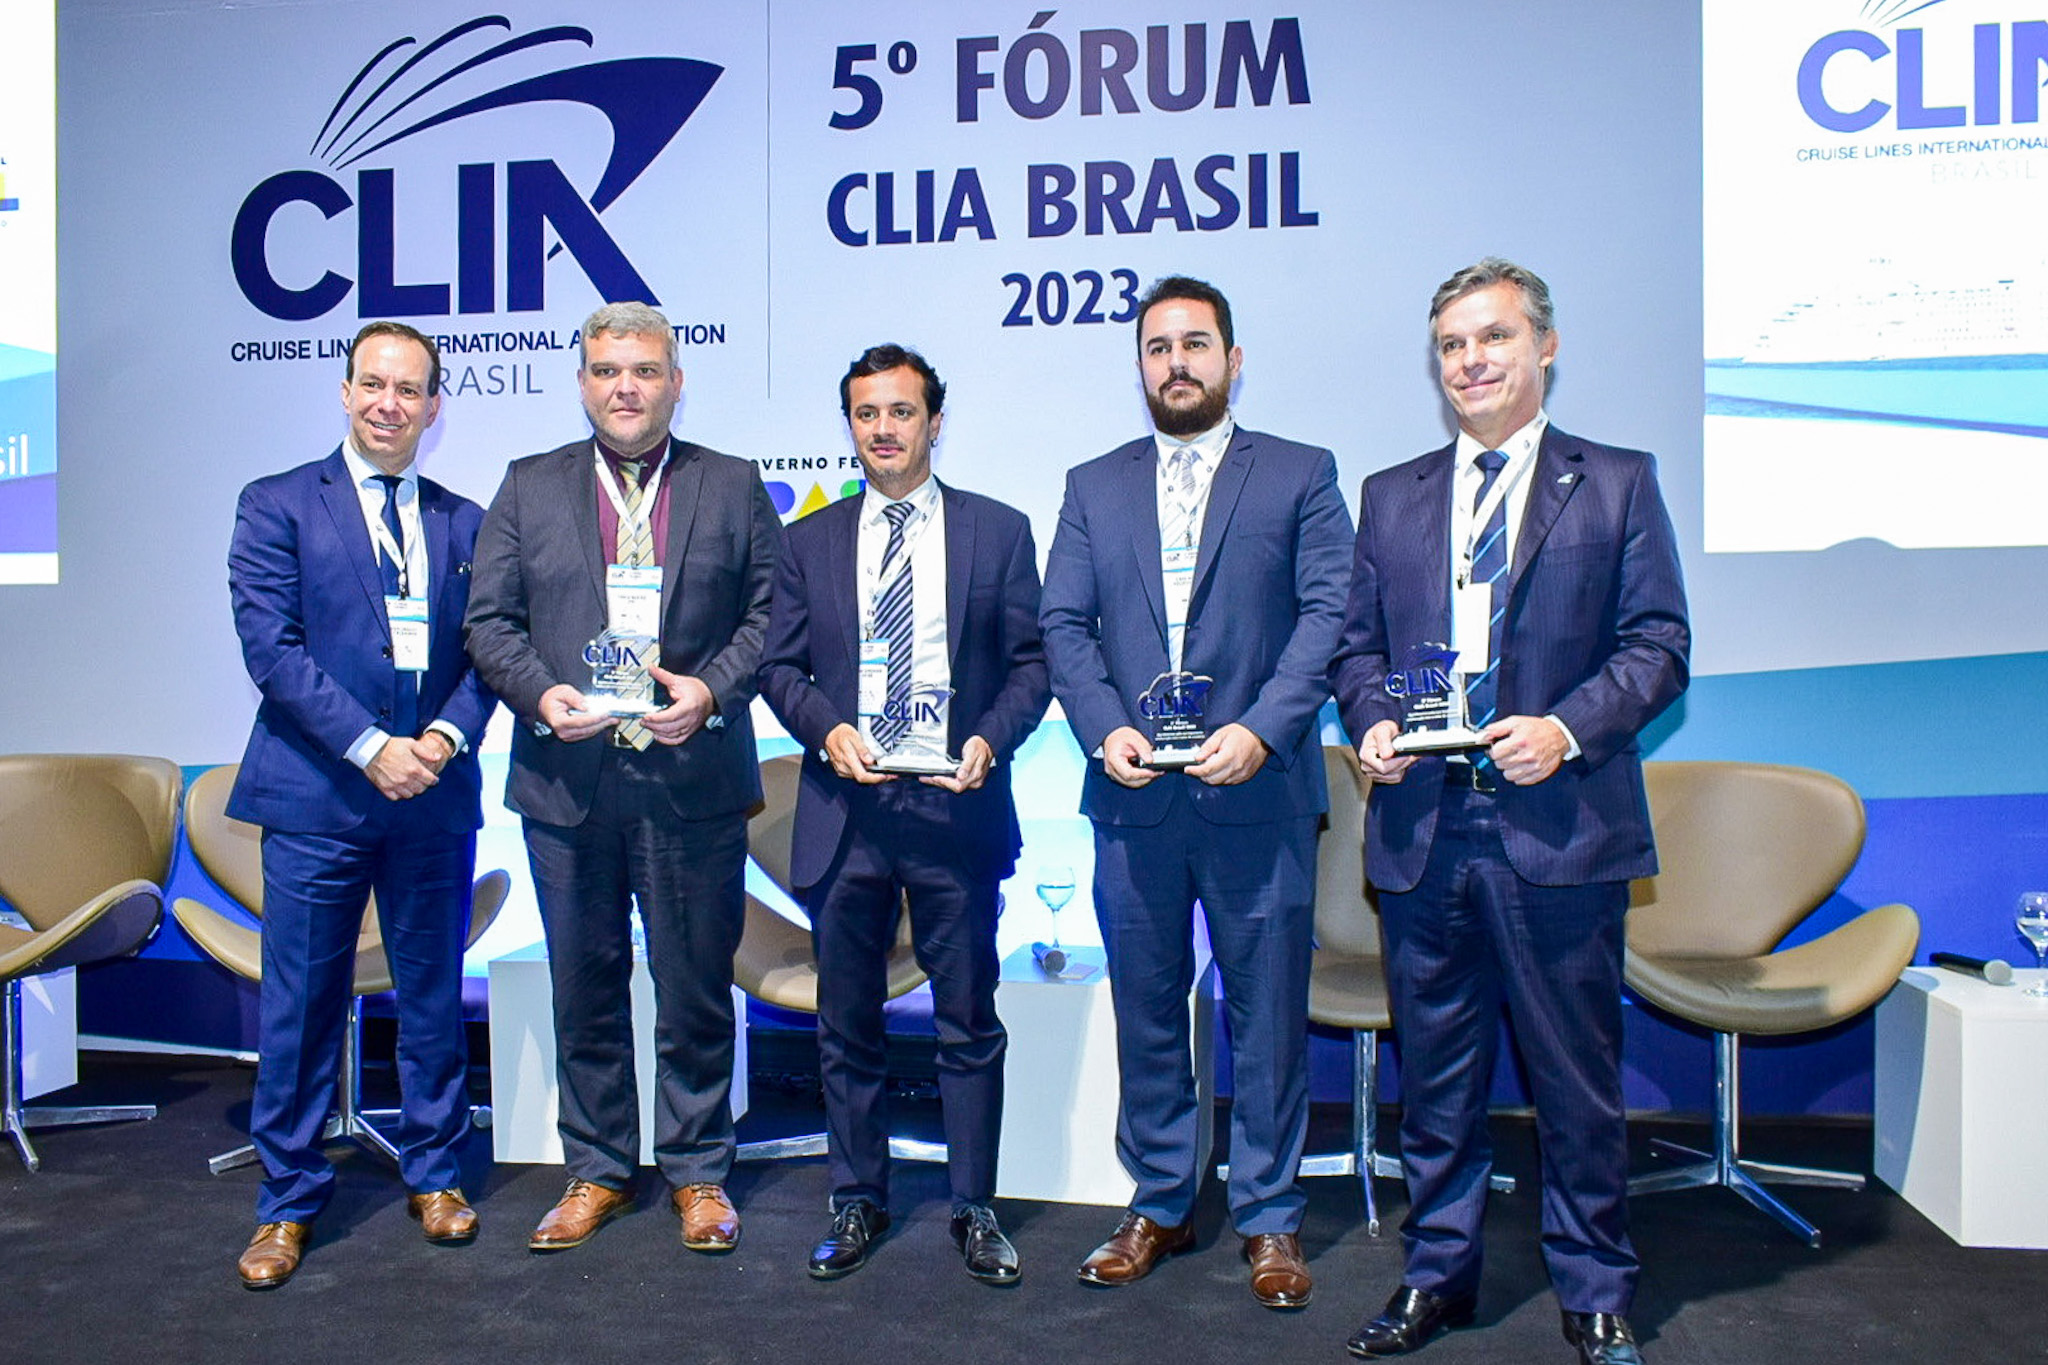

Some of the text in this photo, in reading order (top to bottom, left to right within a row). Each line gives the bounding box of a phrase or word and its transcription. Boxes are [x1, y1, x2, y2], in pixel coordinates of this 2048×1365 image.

[828, 10, 1311, 130] 5º FÓRUM
[1796, 146, 1858, 162] CRUISE
[1865, 143, 1913, 158] LINES
[827, 151, 1319, 247] CLIA BRASIL
[231, 159, 662, 321] CLIA
[1001, 268, 1139, 327] 2023
[231, 340, 311, 361] CRUISE
[318, 338, 353, 358] LIN
[428, 330, 564, 354] RNATIONAL
[440, 364, 544, 396] RASIL
[752, 457, 828, 470] VERNO
